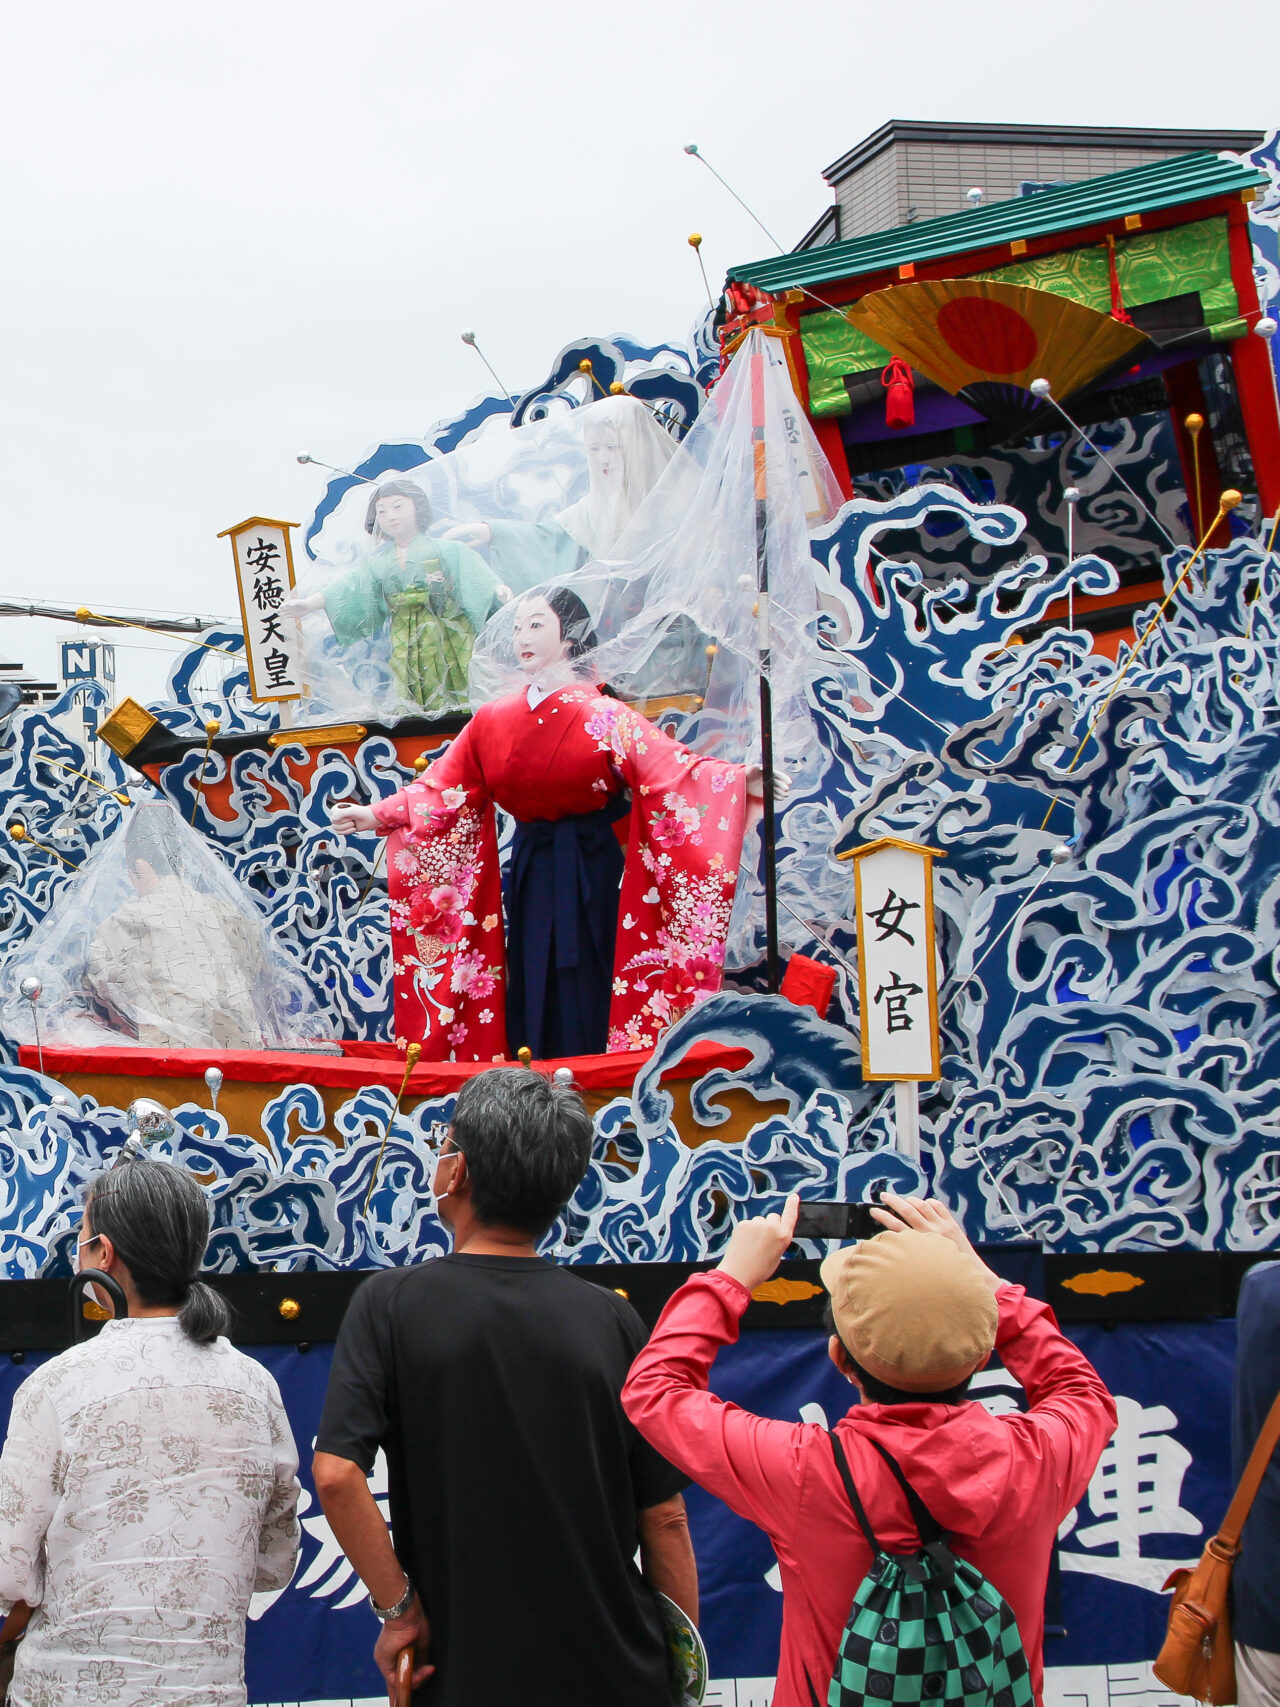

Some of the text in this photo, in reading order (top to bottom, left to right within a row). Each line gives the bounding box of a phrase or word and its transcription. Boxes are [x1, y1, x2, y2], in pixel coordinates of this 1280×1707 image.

[67, 648, 91, 673] N
[246, 537, 296, 690] 安徳天皇
[865, 887, 923, 1035] 女官
